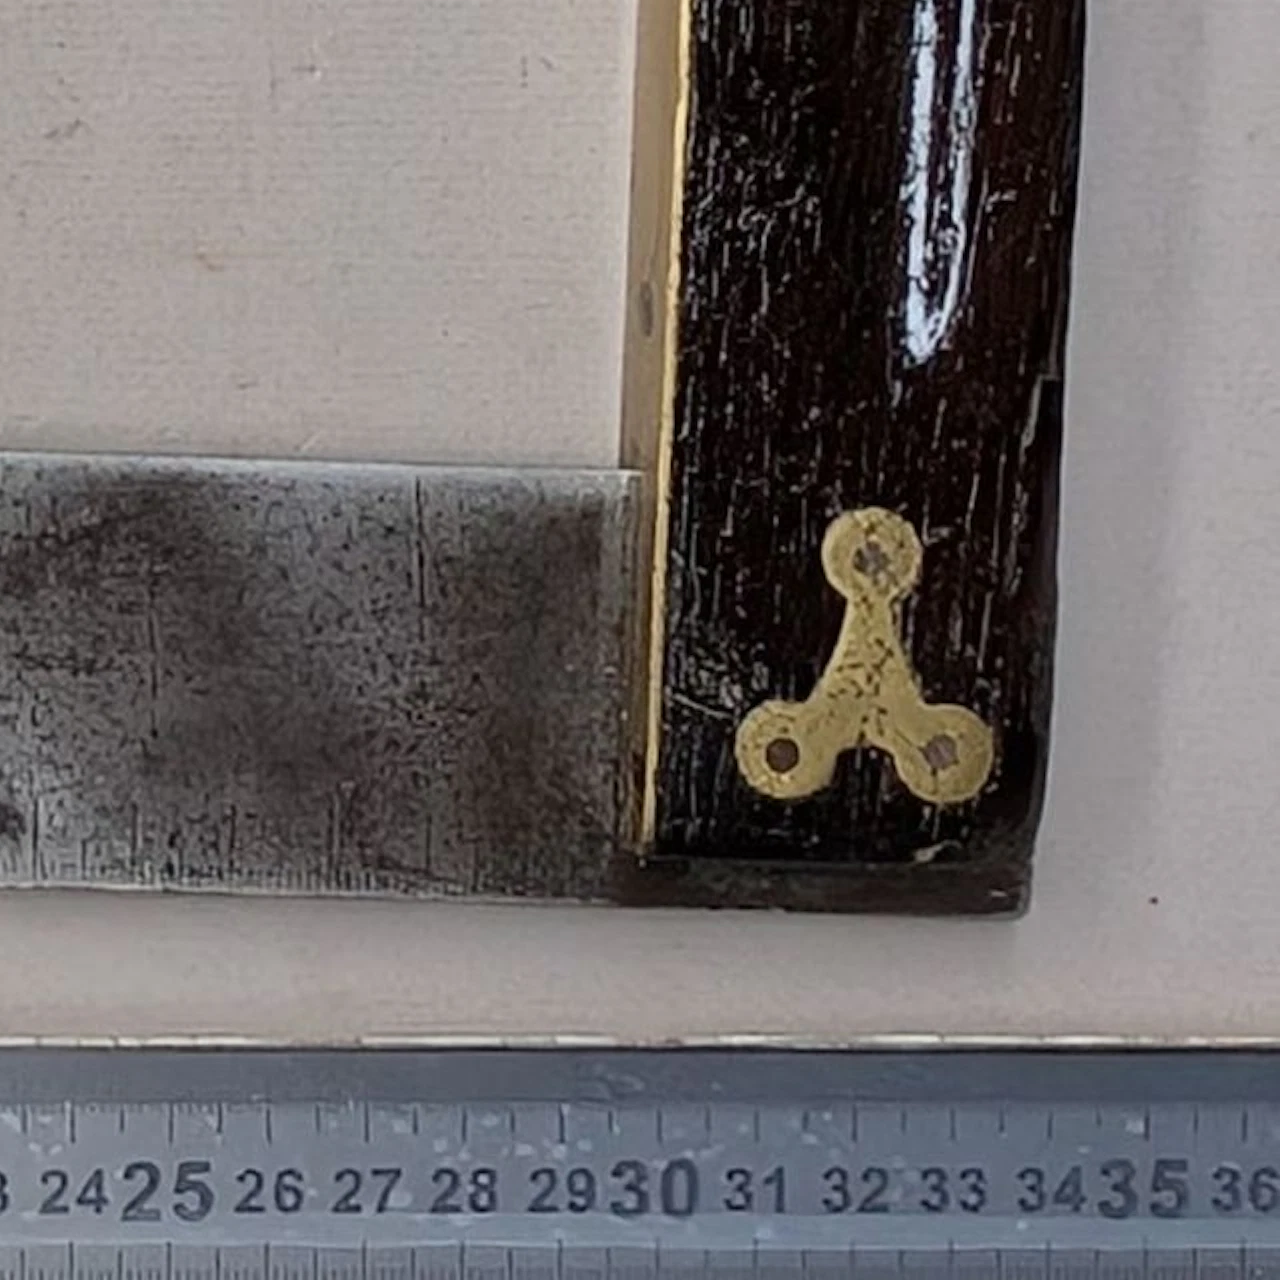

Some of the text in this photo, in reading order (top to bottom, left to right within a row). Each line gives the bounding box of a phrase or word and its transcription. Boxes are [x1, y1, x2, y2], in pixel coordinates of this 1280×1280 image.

[38, 1168, 110, 1215] 24
[120, 1160, 215, 1224] 25
[233, 1167, 305, 1215] 26
[330, 1167, 403, 1215] 27
[428, 1167, 499, 1215] 28
[525, 1167, 597, 1214] 29
[608, 1158, 700, 1221] 30
[723, 1166, 787, 1215] 31
[821, 1166, 891, 1215] 32
[918, 1167, 988, 1215] 33
[1016, 1166, 1087, 1214] 34
[1097, 1157, 1189, 1221] 35
[1211, 1166, 1280, 1215] 36
